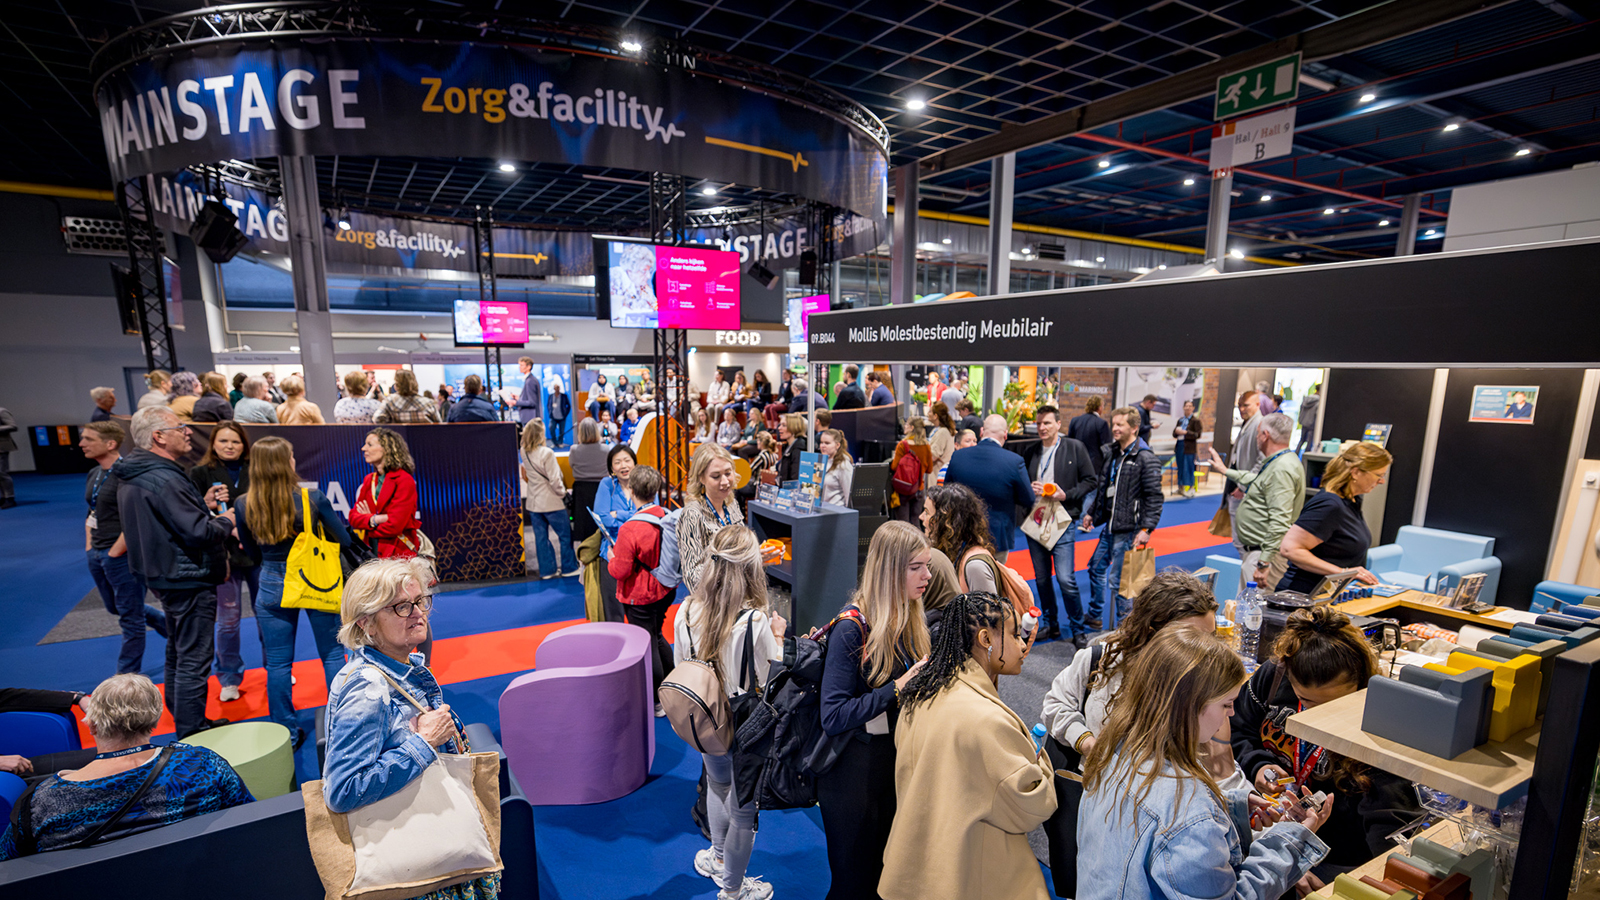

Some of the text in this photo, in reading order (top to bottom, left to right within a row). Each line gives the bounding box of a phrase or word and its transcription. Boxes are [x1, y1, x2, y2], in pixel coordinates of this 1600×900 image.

[421, 77, 666, 142] Zorg&facility
[1235, 132, 1251, 145] Hal
[1260, 124, 1281, 139] Hall
[1283, 123, 1290, 133] 9
[1254, 142, 1265, 160] B
[715, 330, 762, 346] FOOD
[810, 316, 1053, 345] 09.B044 Mollis Molestbestendig Meubilair
